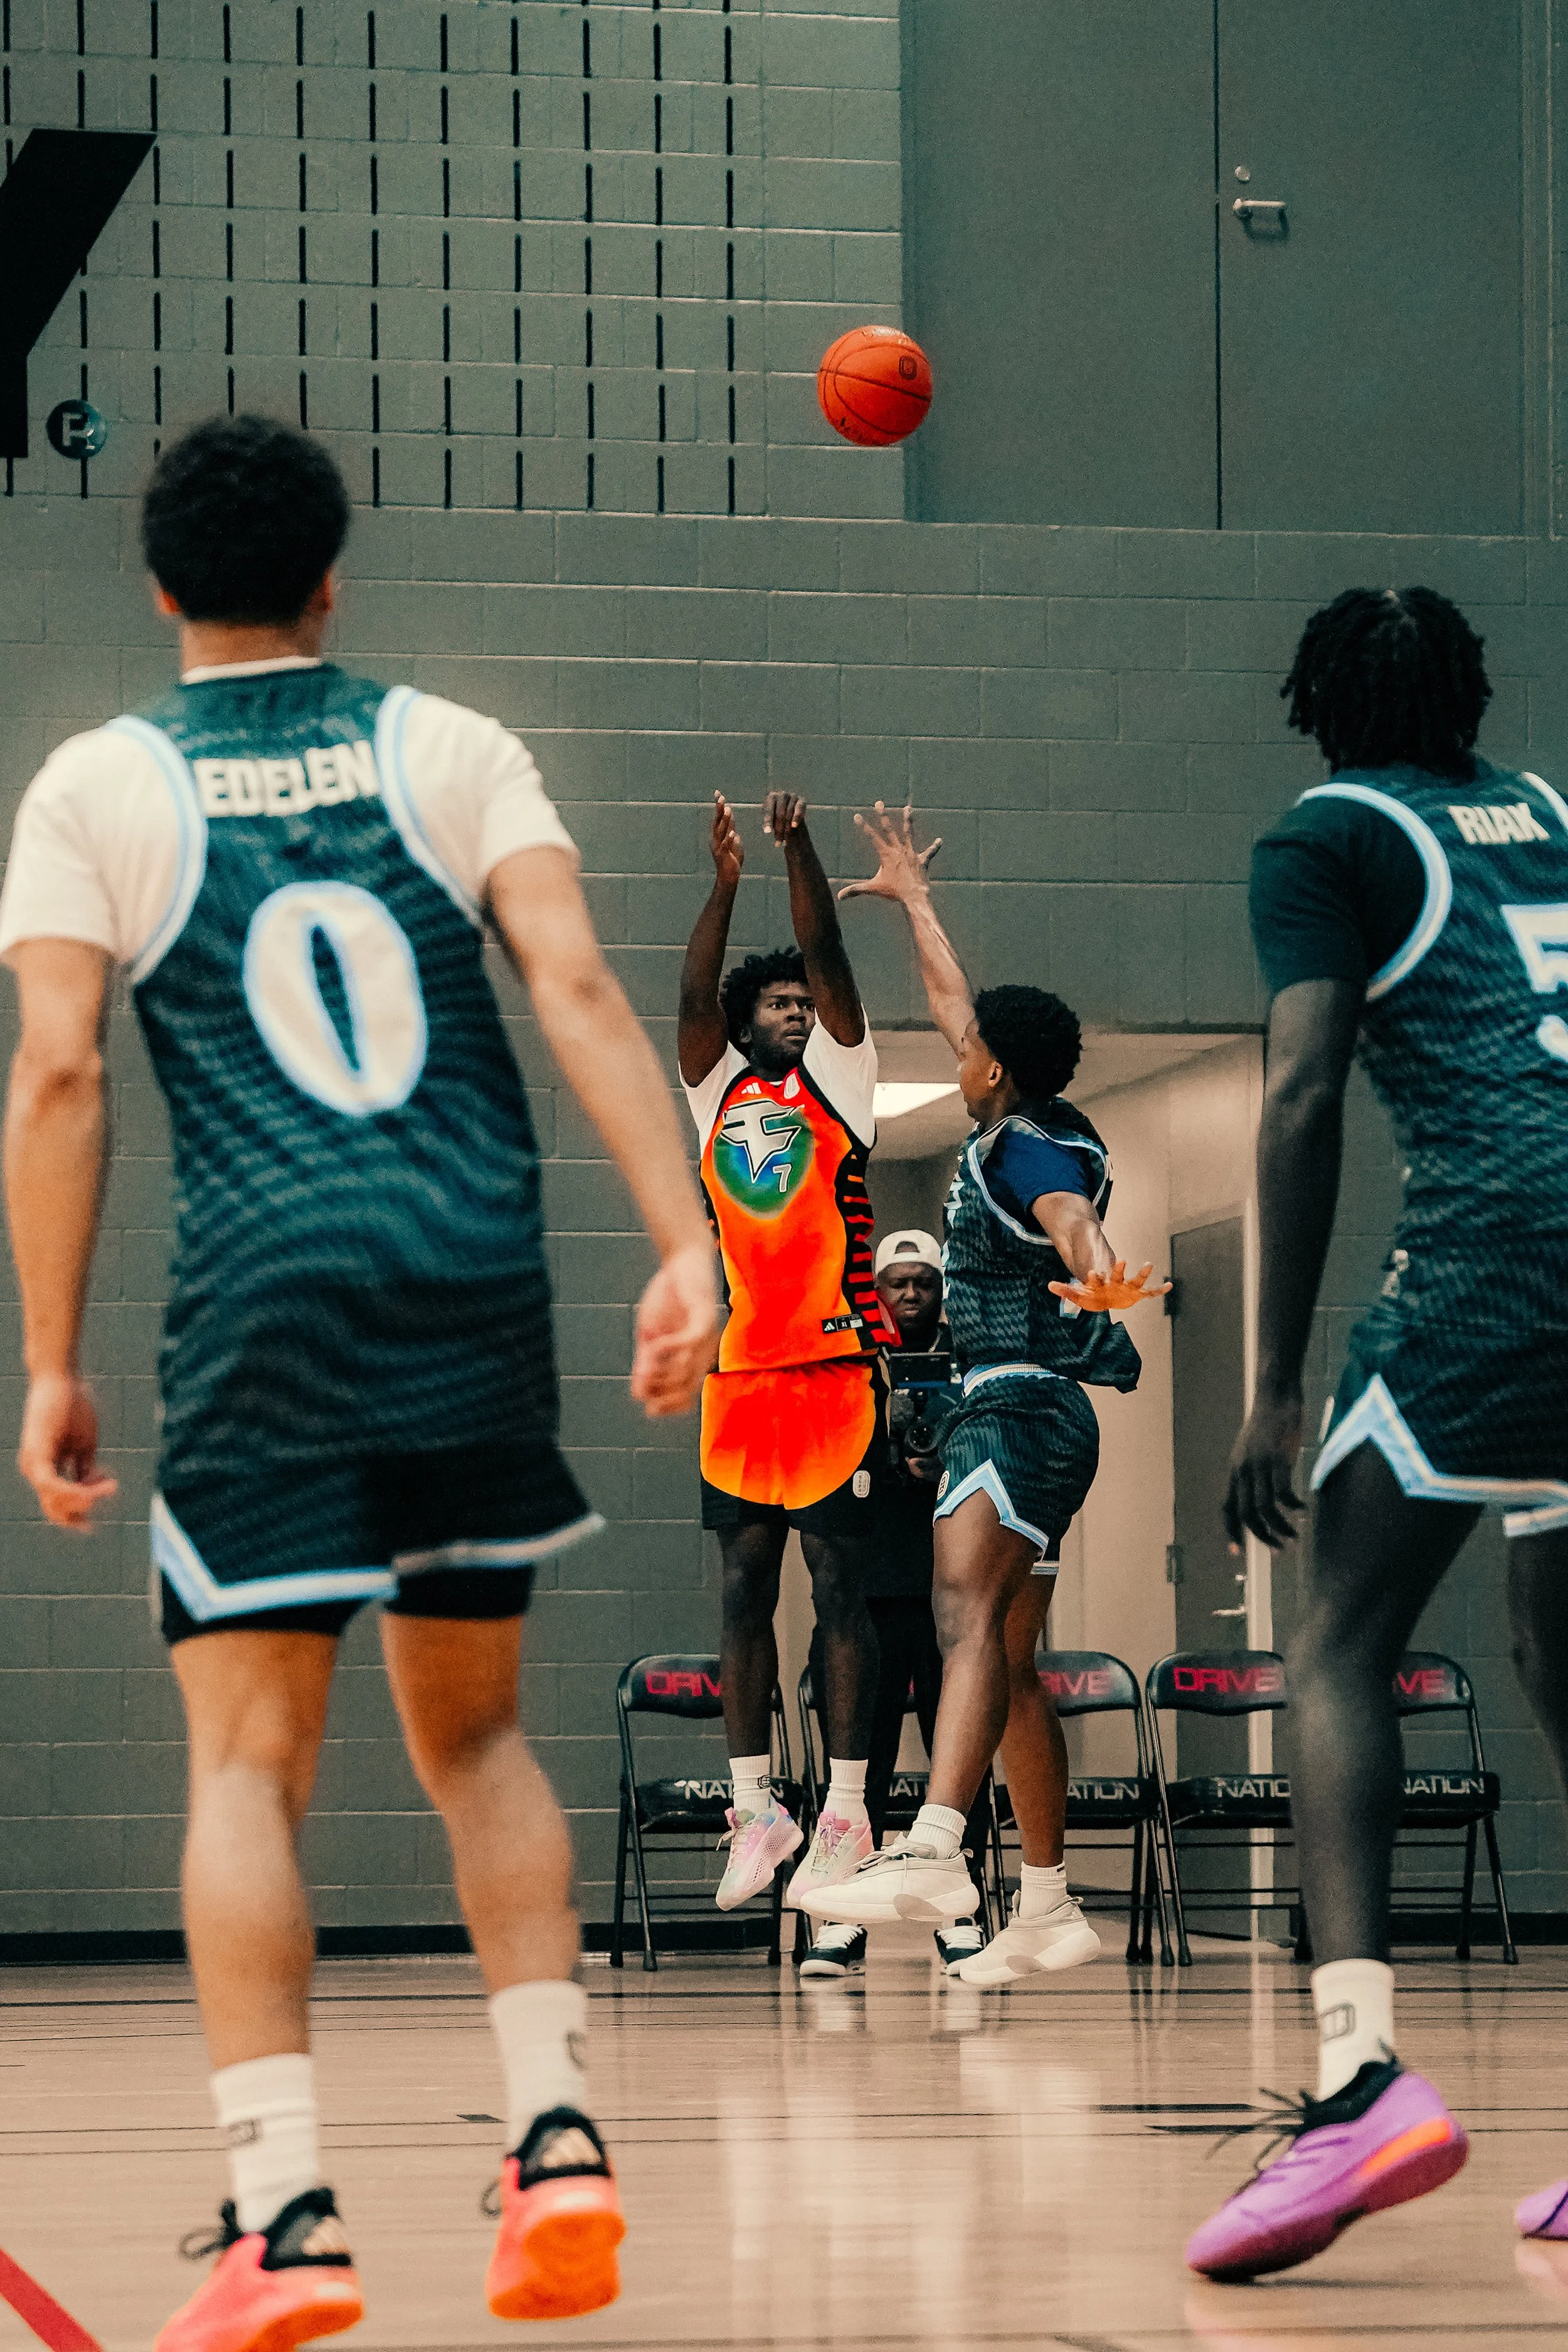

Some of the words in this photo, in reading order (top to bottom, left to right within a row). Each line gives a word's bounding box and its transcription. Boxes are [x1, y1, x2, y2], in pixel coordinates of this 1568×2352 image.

[193, 741, 378, 817] EDELEN
[1448, 802, 1550, 844] RIAK
[242, 881, 429, 1116] 0
[773, 1163, 792, 1193] 7
[646, 1670, 721, 1697] DRIV
[1173, 1667, 1282, 1693] DRIVE
[1067, 1781, 1140, 1799] ATION
[1215, 1779, 1291, 1798] NATIO
